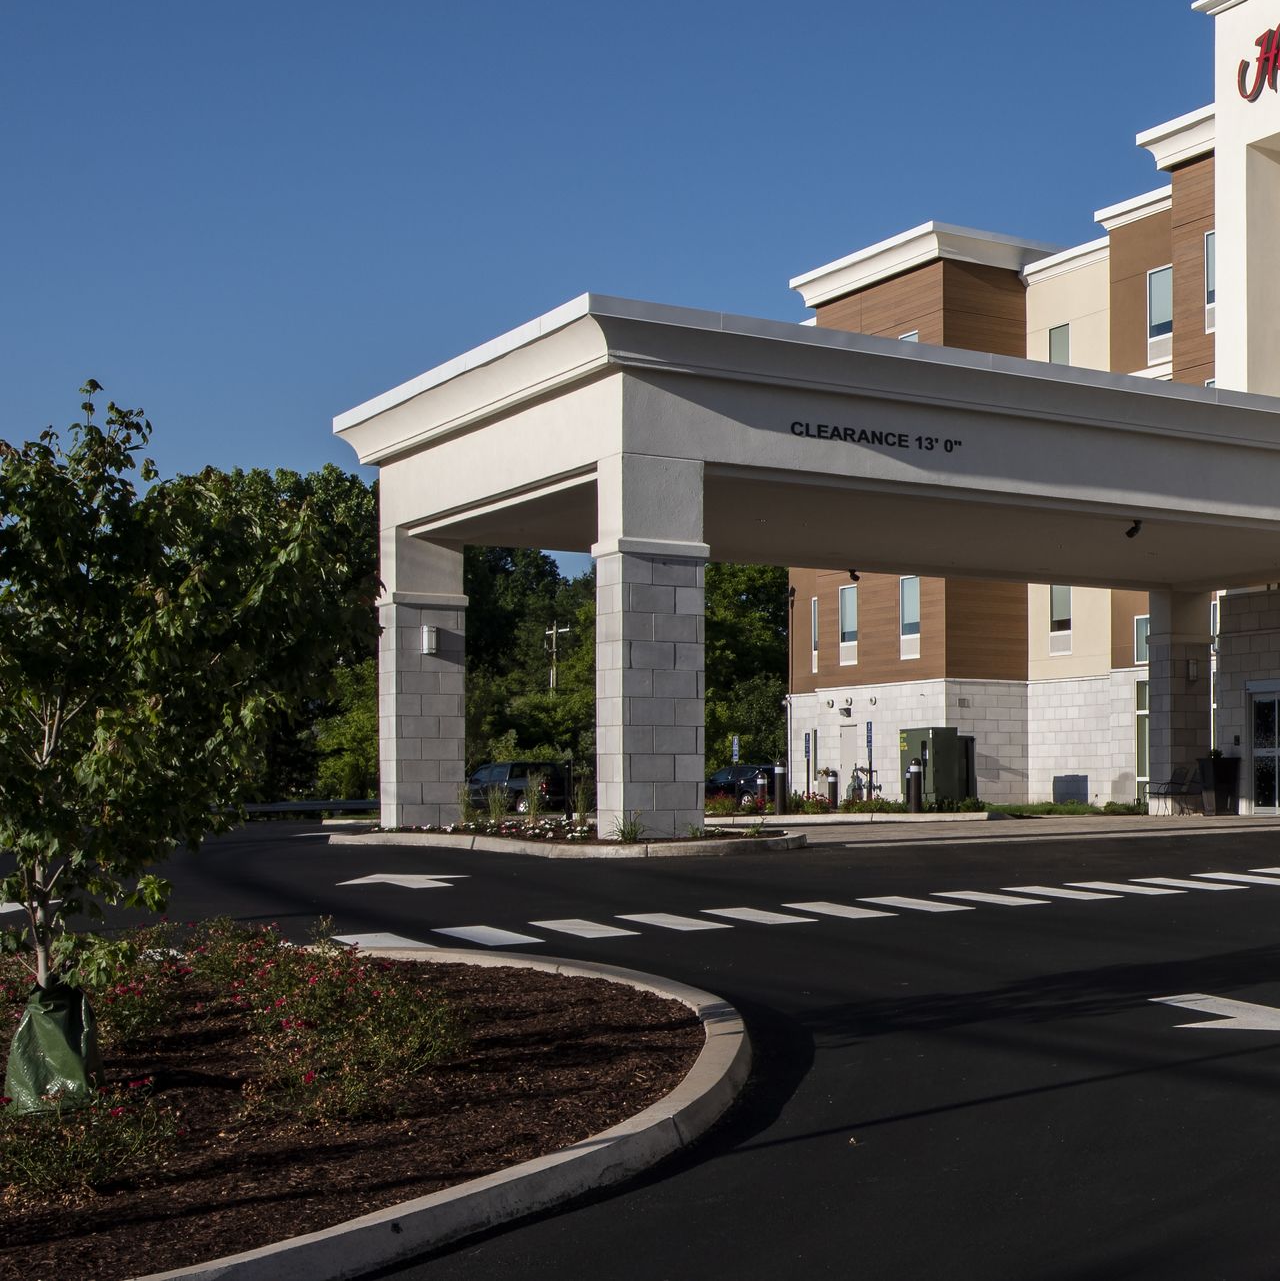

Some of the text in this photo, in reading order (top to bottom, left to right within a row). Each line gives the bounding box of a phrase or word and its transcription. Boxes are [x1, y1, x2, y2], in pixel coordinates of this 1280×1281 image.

[790, 422, 963, 453] CLEARANCE 13' 0"
